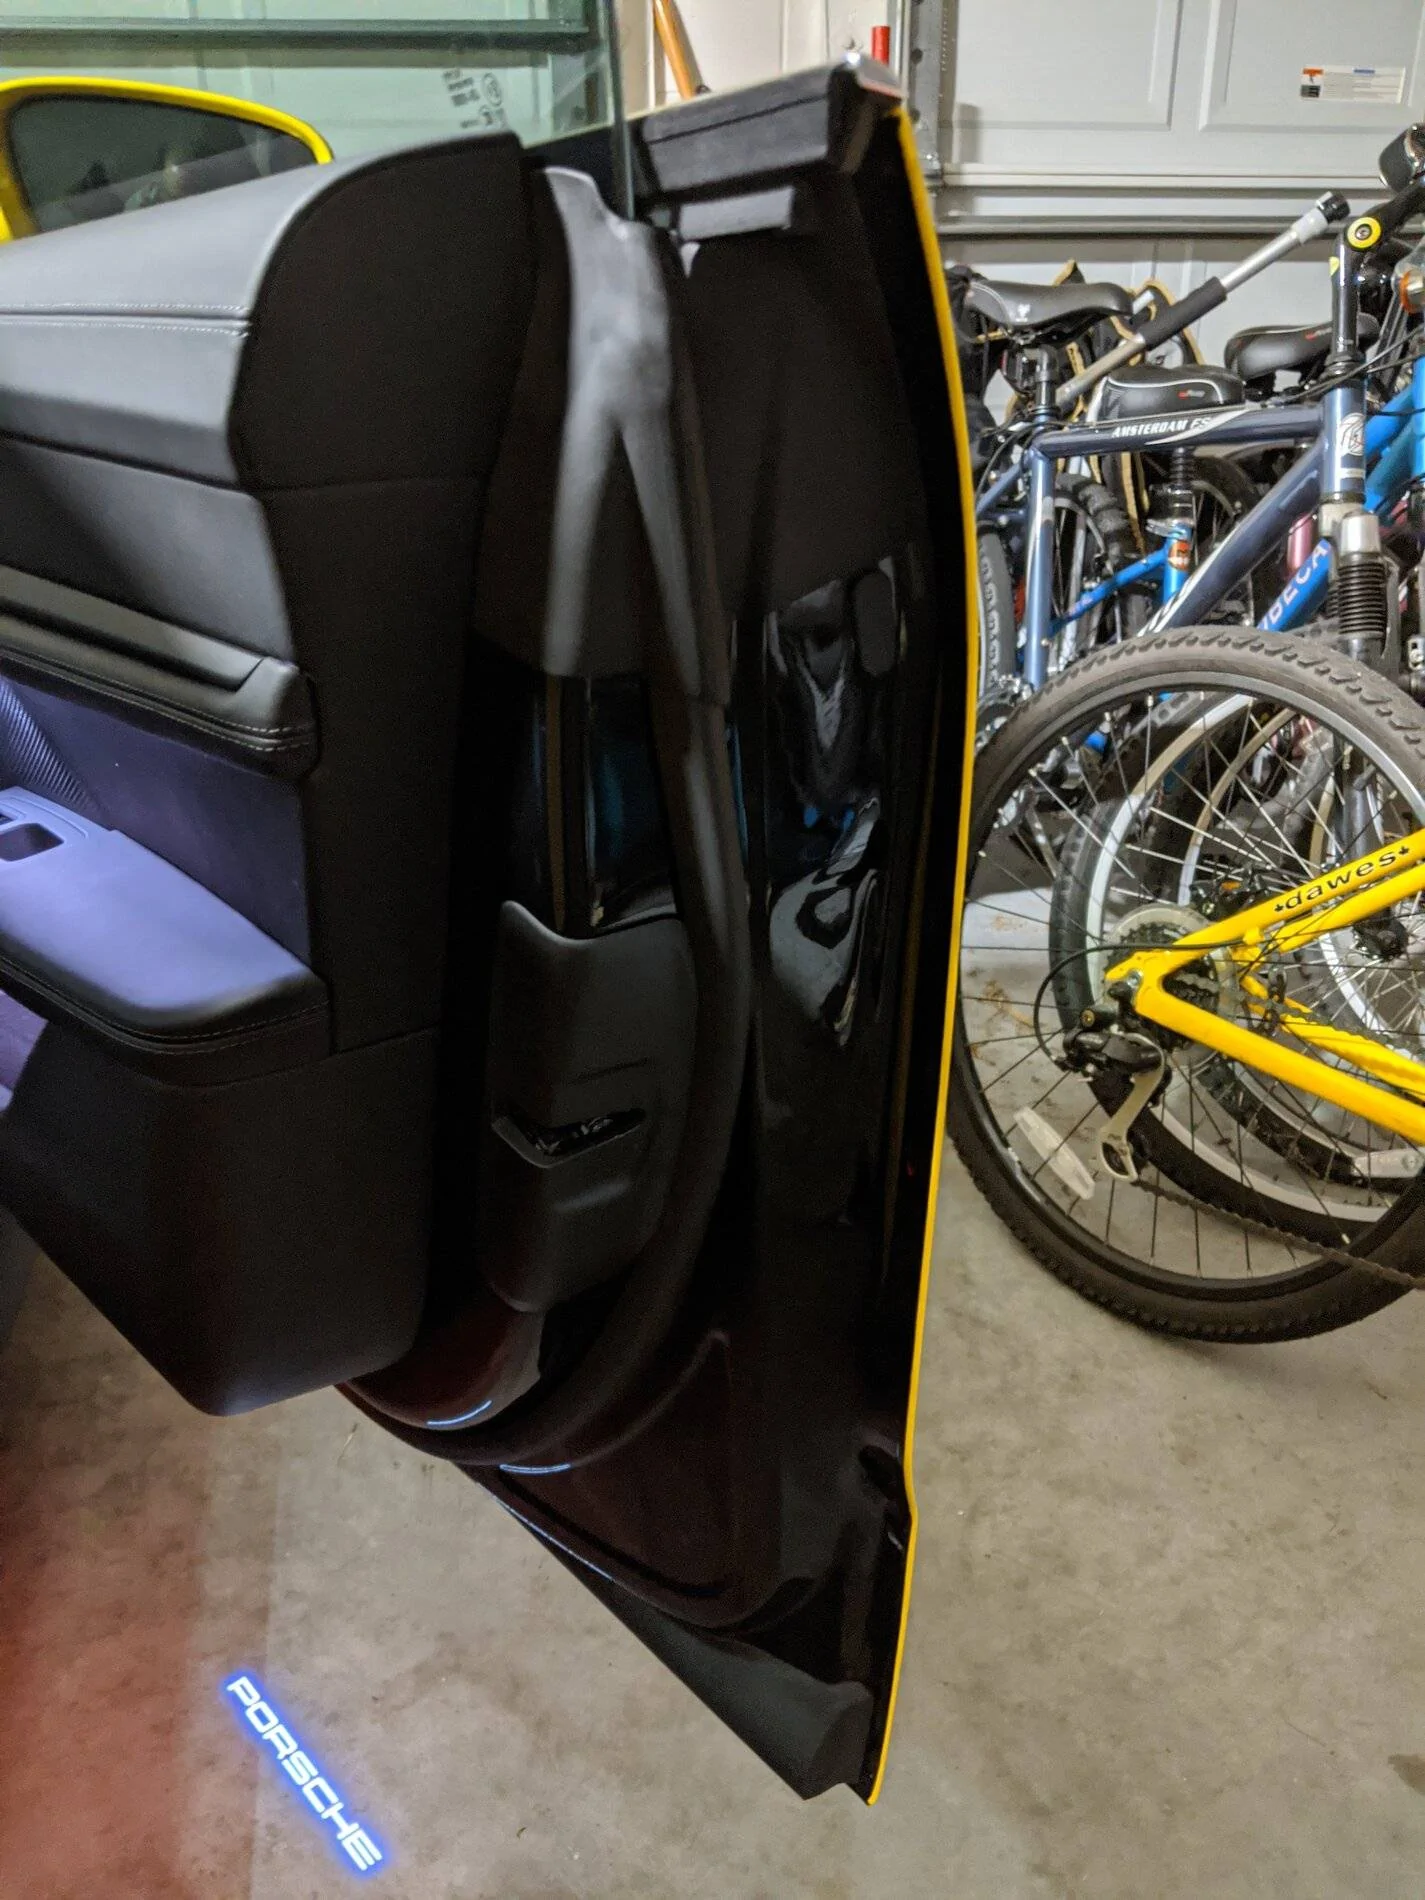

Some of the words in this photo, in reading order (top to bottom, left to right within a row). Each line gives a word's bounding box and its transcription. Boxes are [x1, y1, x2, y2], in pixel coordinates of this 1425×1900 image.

[1111, 419, 1188, 438] AMSTERDAM
[1285, 851, 1397, 909] dawes
[226, 1676, 383, 1871] PORSCHE
